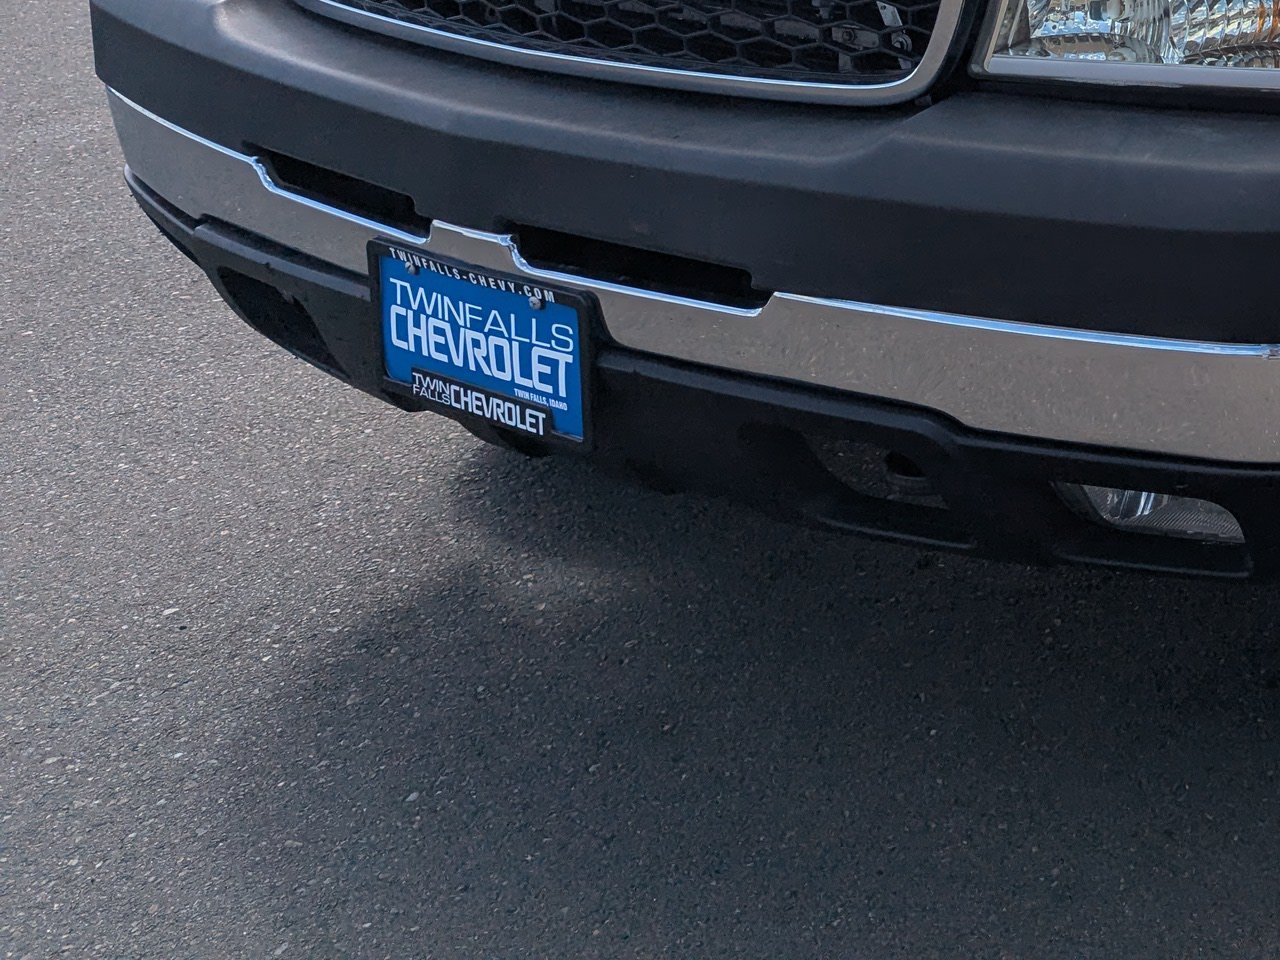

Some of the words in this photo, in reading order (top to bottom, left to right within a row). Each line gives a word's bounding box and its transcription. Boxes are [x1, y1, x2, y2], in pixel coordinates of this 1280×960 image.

[389, 247, 556, 303] TWINFALLS-CHEVY.COM
[389, 304, 574, 398] CHEVROLET
[411, 372, 450, 395] TWIN
[412, 384, 451, 405] FALLS
[514, 388, 531, 399] TWIN
[549, 398, 568, 411] IDAHO
[450, 384, 547, 436] CHEVROLET
